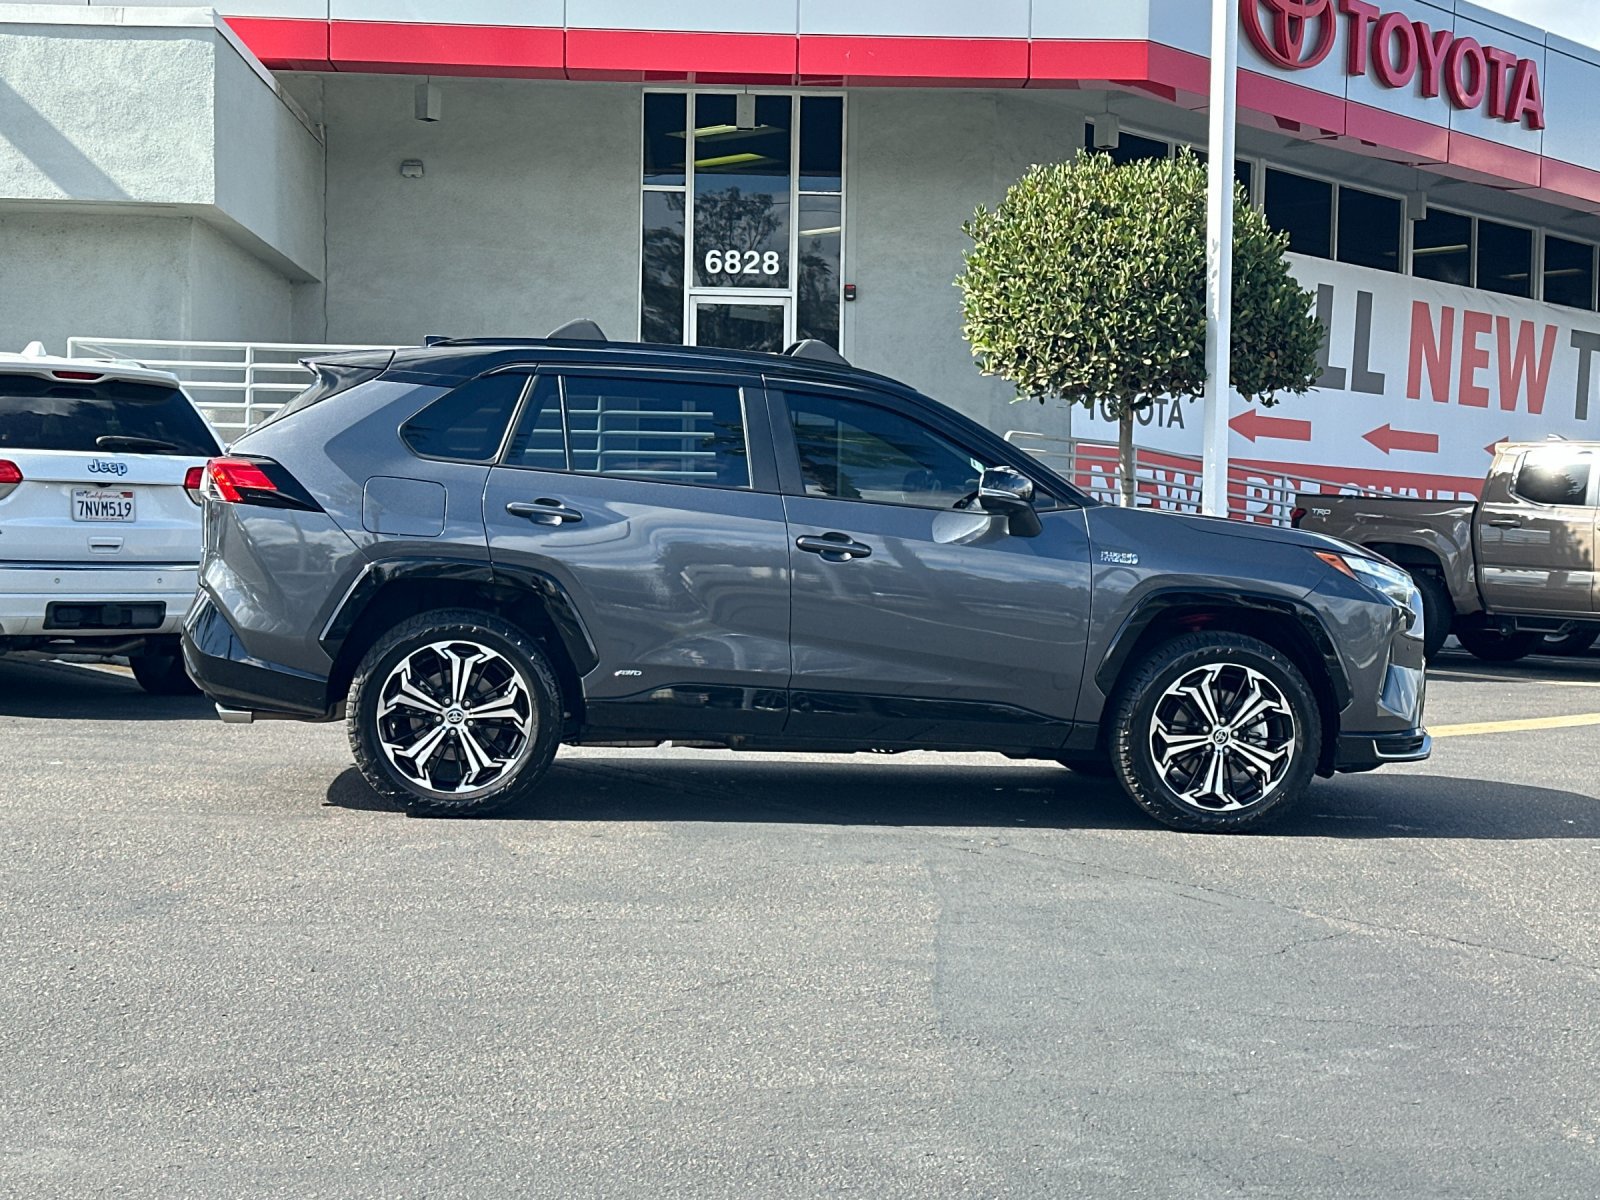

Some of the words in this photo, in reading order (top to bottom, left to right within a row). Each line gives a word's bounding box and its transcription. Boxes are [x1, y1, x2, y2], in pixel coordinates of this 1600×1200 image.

[1339, 0, 1545, 129] TOYOTA
[705, 250, 780, 275] 6828
[1314, 283, 1385, 395] LL
[1407, 300, 1558, 415] NEW
[1085, 395, 1185, 429] OOTA
[88, 459, 128, 476] Jeep
[77, 500, 132, 517] 7NVM519
[1246, 477, 1320, 528] PR
[1311, 507, 1331, 516] TRD
